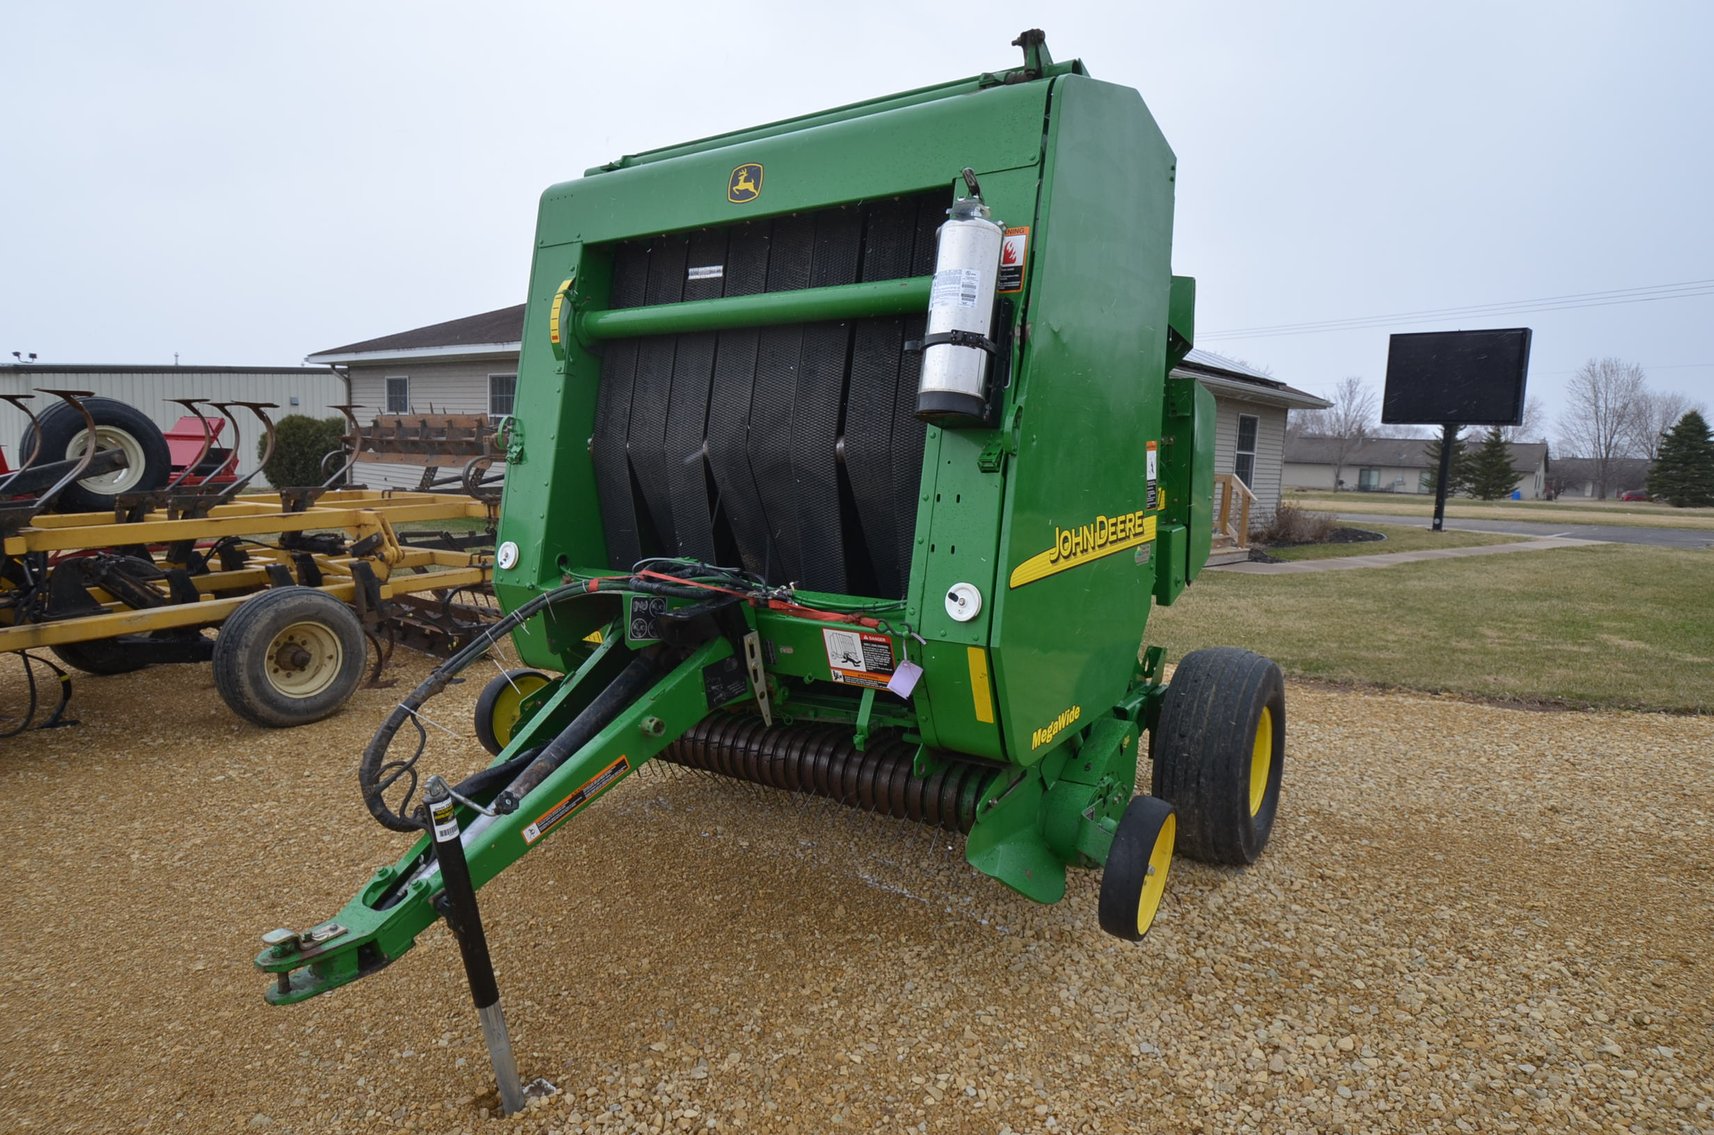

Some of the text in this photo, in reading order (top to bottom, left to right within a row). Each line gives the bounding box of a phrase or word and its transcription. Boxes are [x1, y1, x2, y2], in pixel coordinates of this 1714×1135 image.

[1051, 524, 1095, 561] JOHN
[1096, 511, 1144, 546] DEERE
[1032, 706, 1081, 750] MegaWide
